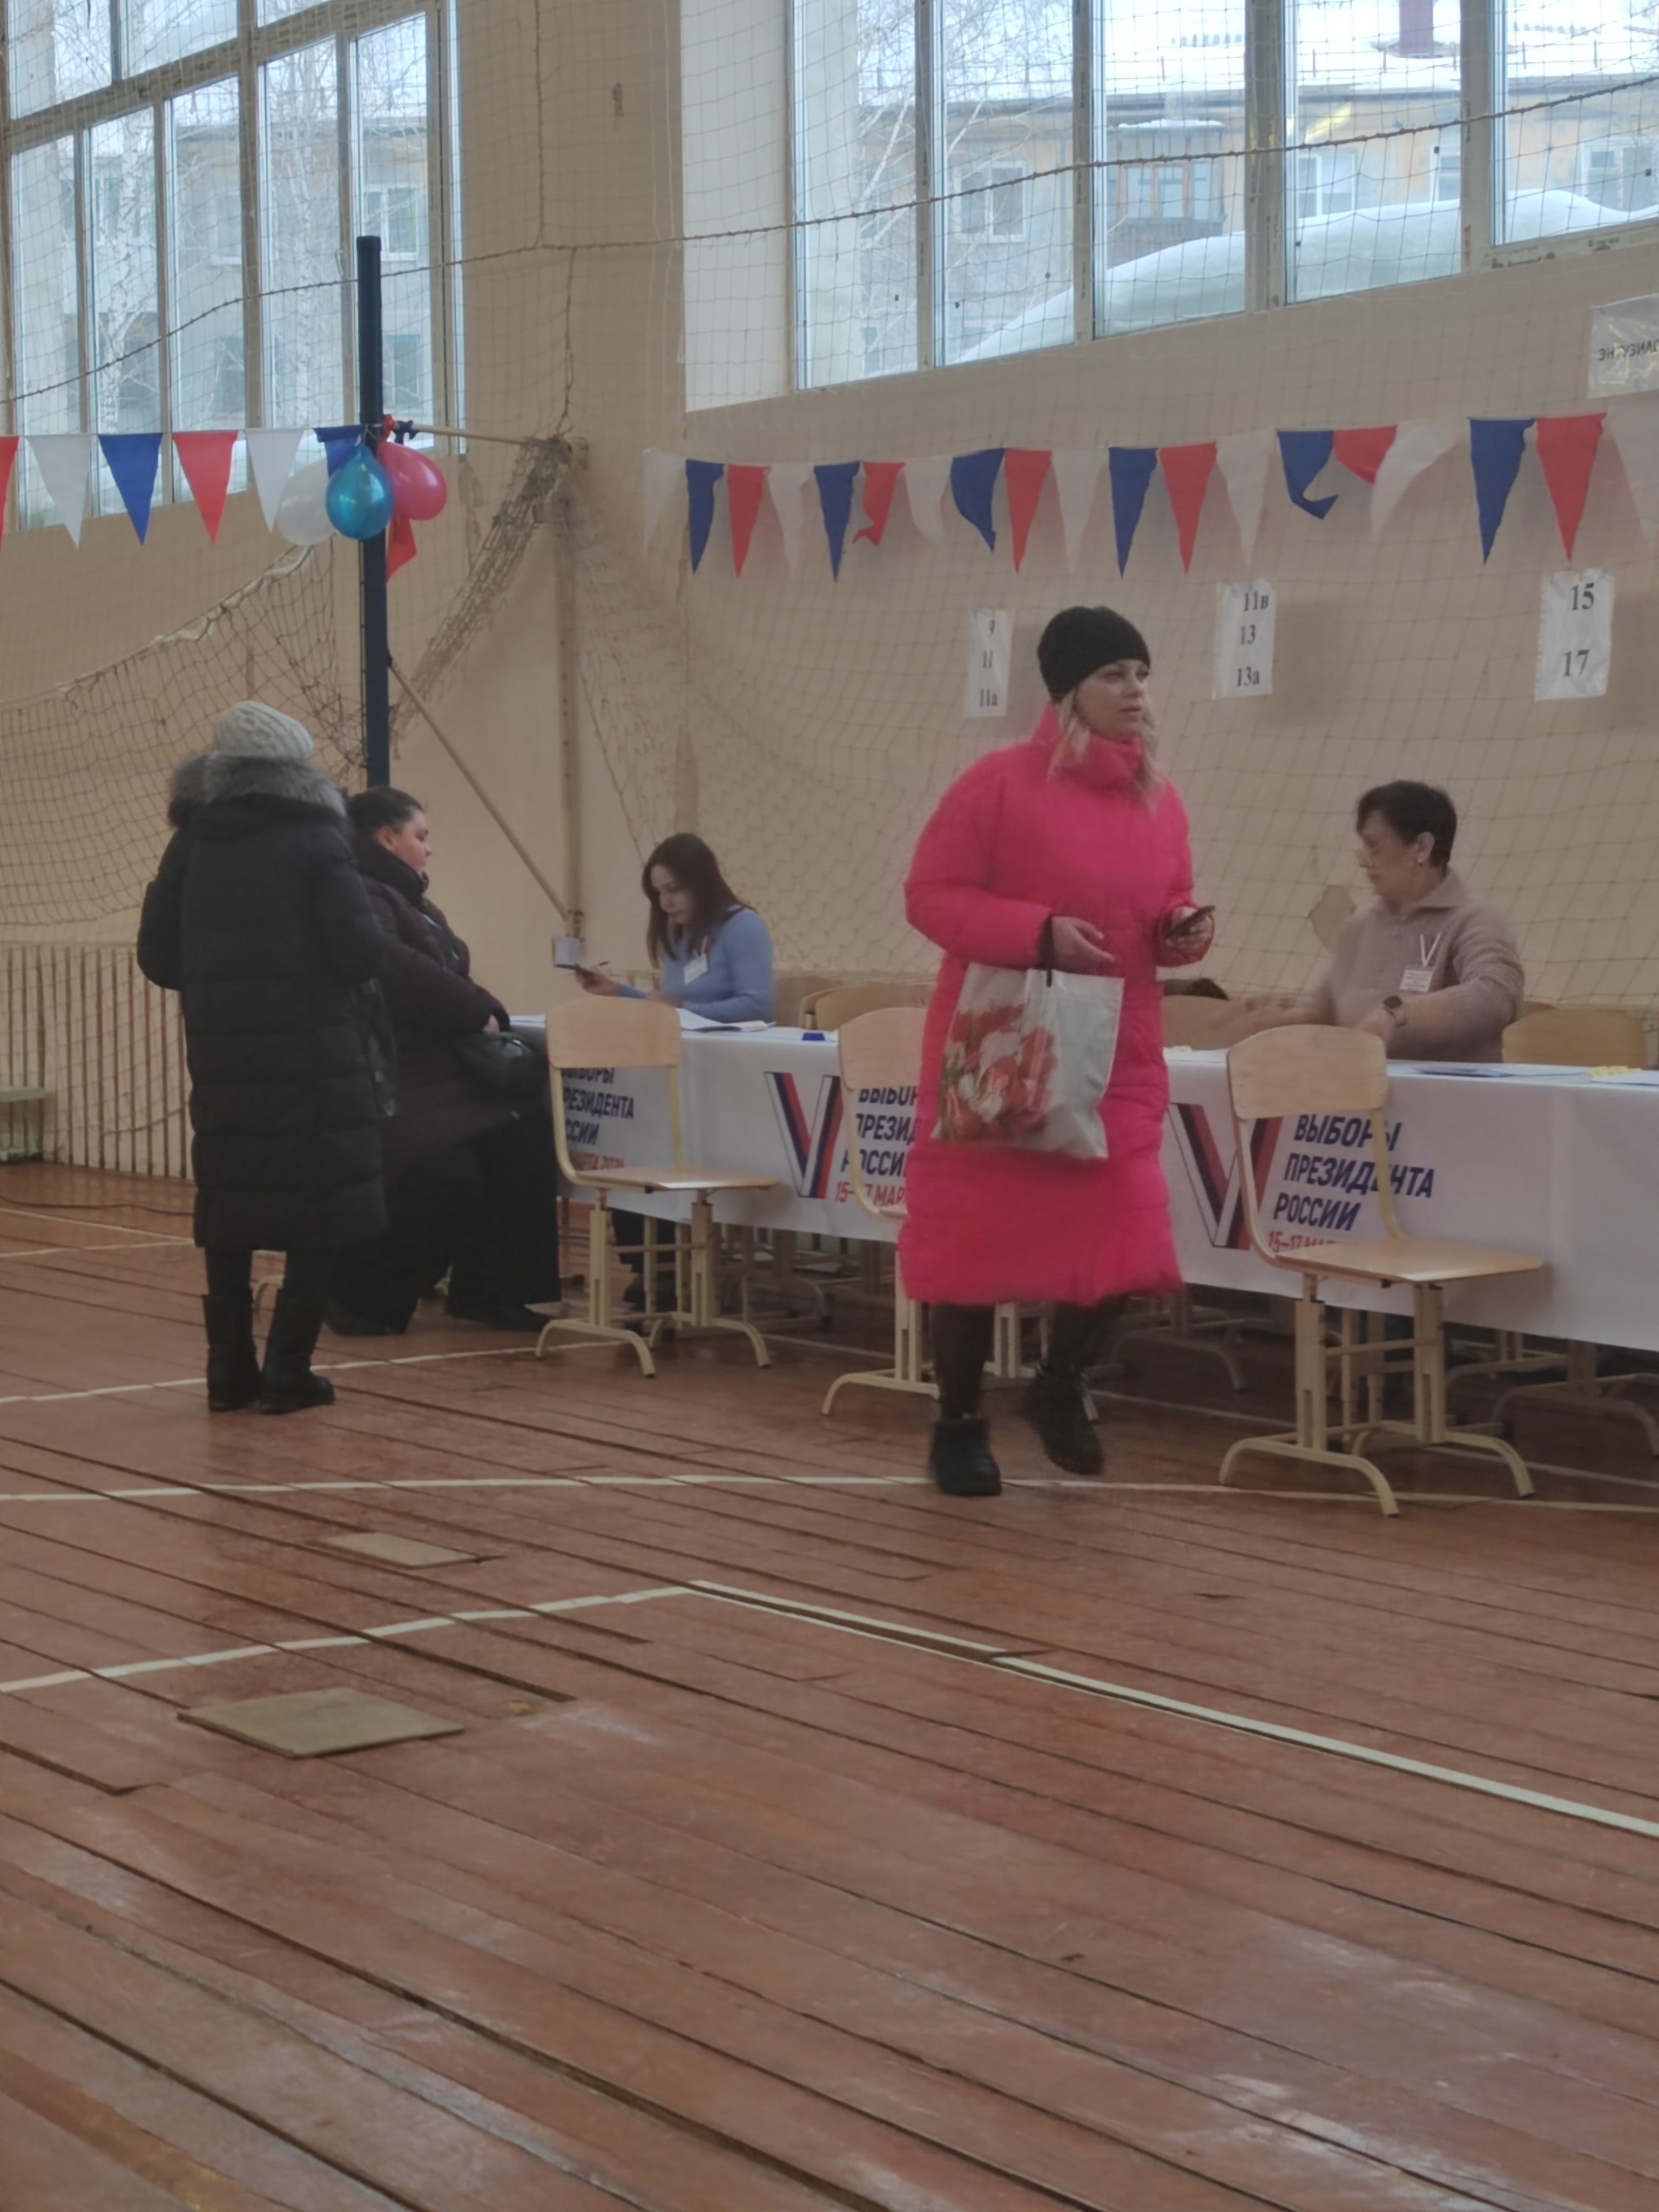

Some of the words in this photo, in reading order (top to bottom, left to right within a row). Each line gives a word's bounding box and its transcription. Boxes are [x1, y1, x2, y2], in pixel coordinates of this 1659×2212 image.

[1570, 582, 1595, 610] 15
[1240, 624, 1256, 645] 13
[982, 650, 994, 669] 11
[1563, 649, 1590, 677] 17
[1236, 666, 1260, 687] 13а
[563, 1087, 634, 1120] РЕЗИДЕНТА
[858, 1087, 917, 1106] ВЫБО
[565, 1118, 599, 1145] ССИИ
[840, 1148, 906, 1177] ОССИ
[1284, 1153, 1434, 1198] ПРЕЗИДНТА
[1273, 1192, 1361, 1231] РОССИИ
